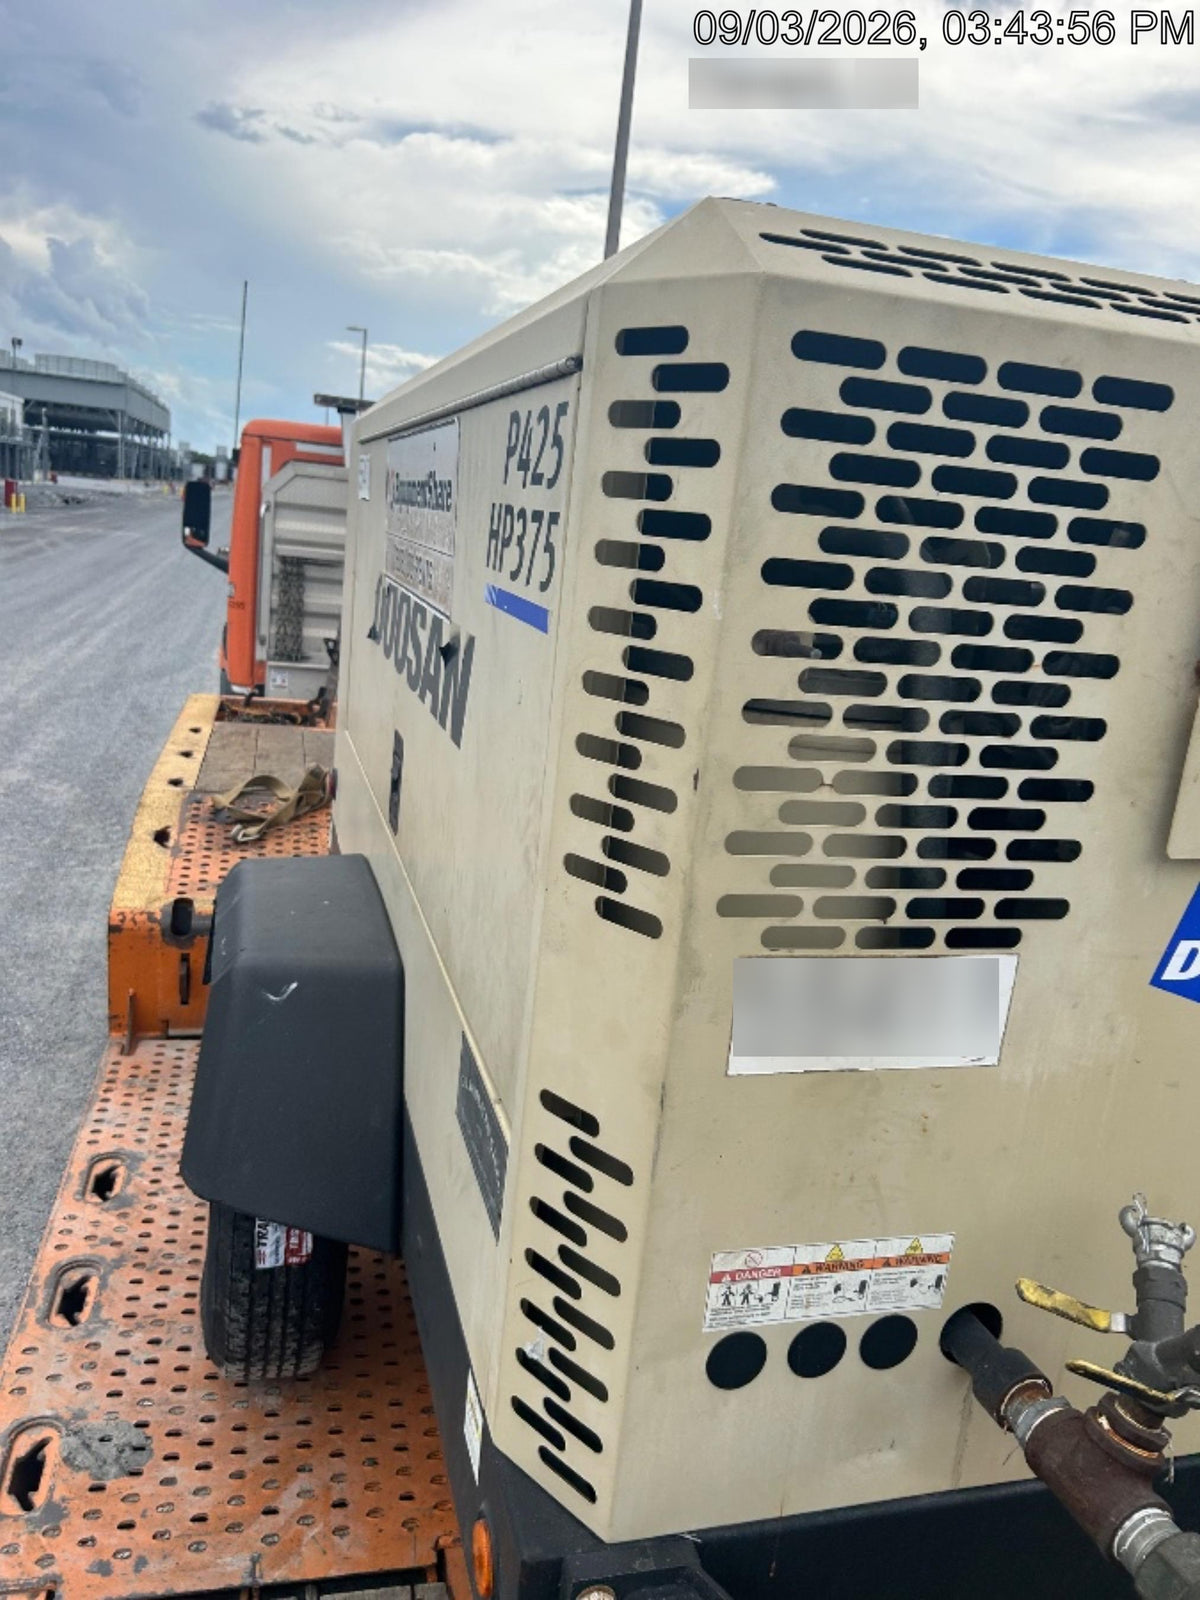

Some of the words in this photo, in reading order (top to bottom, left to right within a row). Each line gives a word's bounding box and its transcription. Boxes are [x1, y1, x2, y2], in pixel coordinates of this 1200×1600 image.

[504, 400, 569, 490] P425
[486, 502, 560, 593] HP375
[735, 1268, 781, 1281] DANGER
